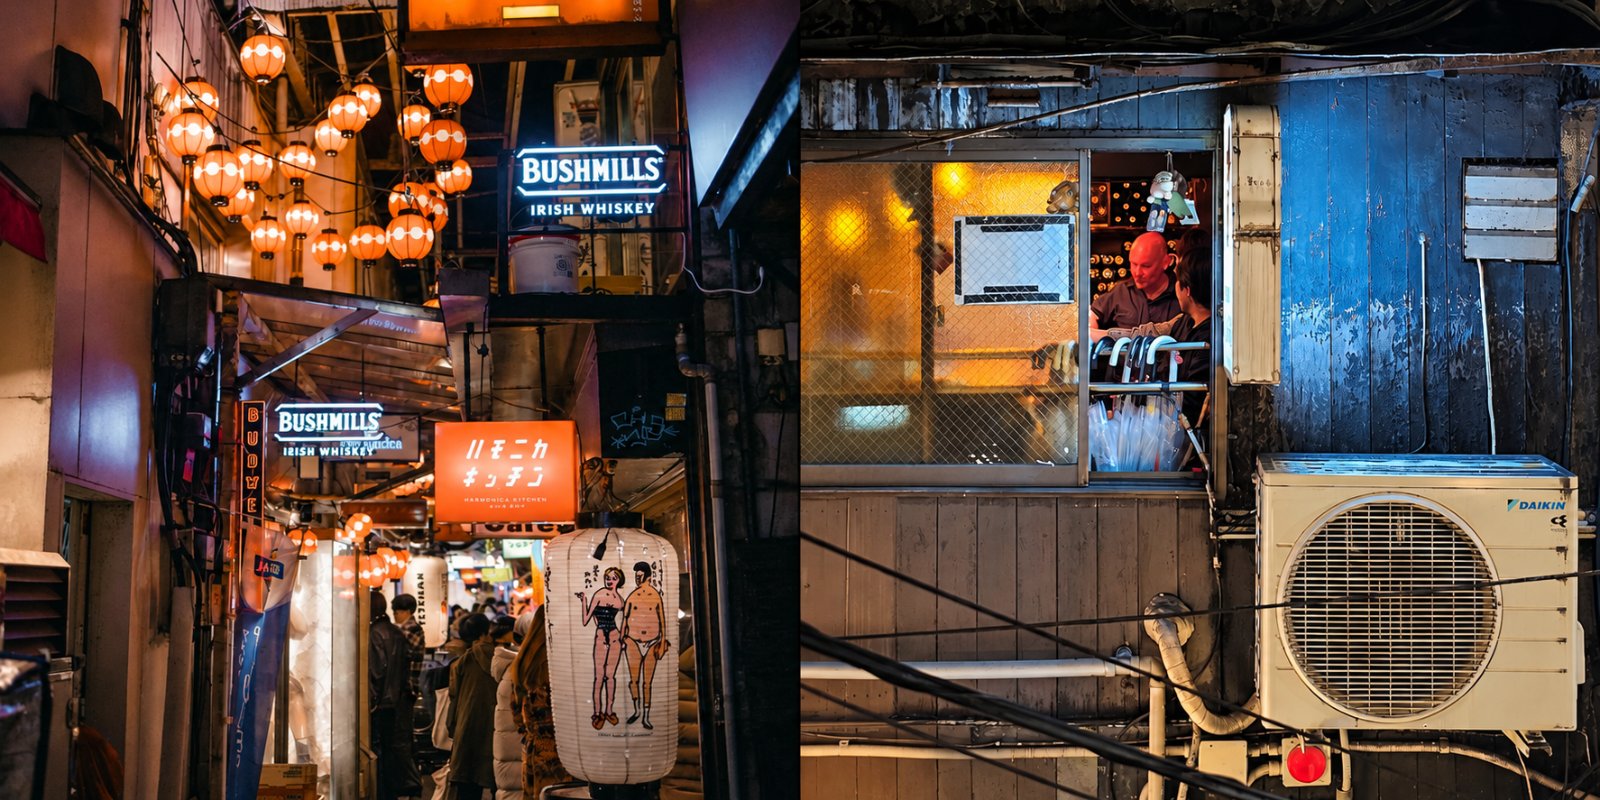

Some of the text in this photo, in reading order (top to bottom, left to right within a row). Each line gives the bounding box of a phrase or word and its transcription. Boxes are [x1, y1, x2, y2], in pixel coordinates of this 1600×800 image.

[522, 157, 660, 184] BUSHMILLS
[531, 202, 655, 216] IRISH WHISKEY
[279, 411, 381, 432] BUSHMILLS
[320, 446, 375, 457] WHISKEY
[466, 438, 548, 460] ハモニカ
[463, 466, 544, 488] キッチン
[1519, 501, 1566, 510] DAIKIN
